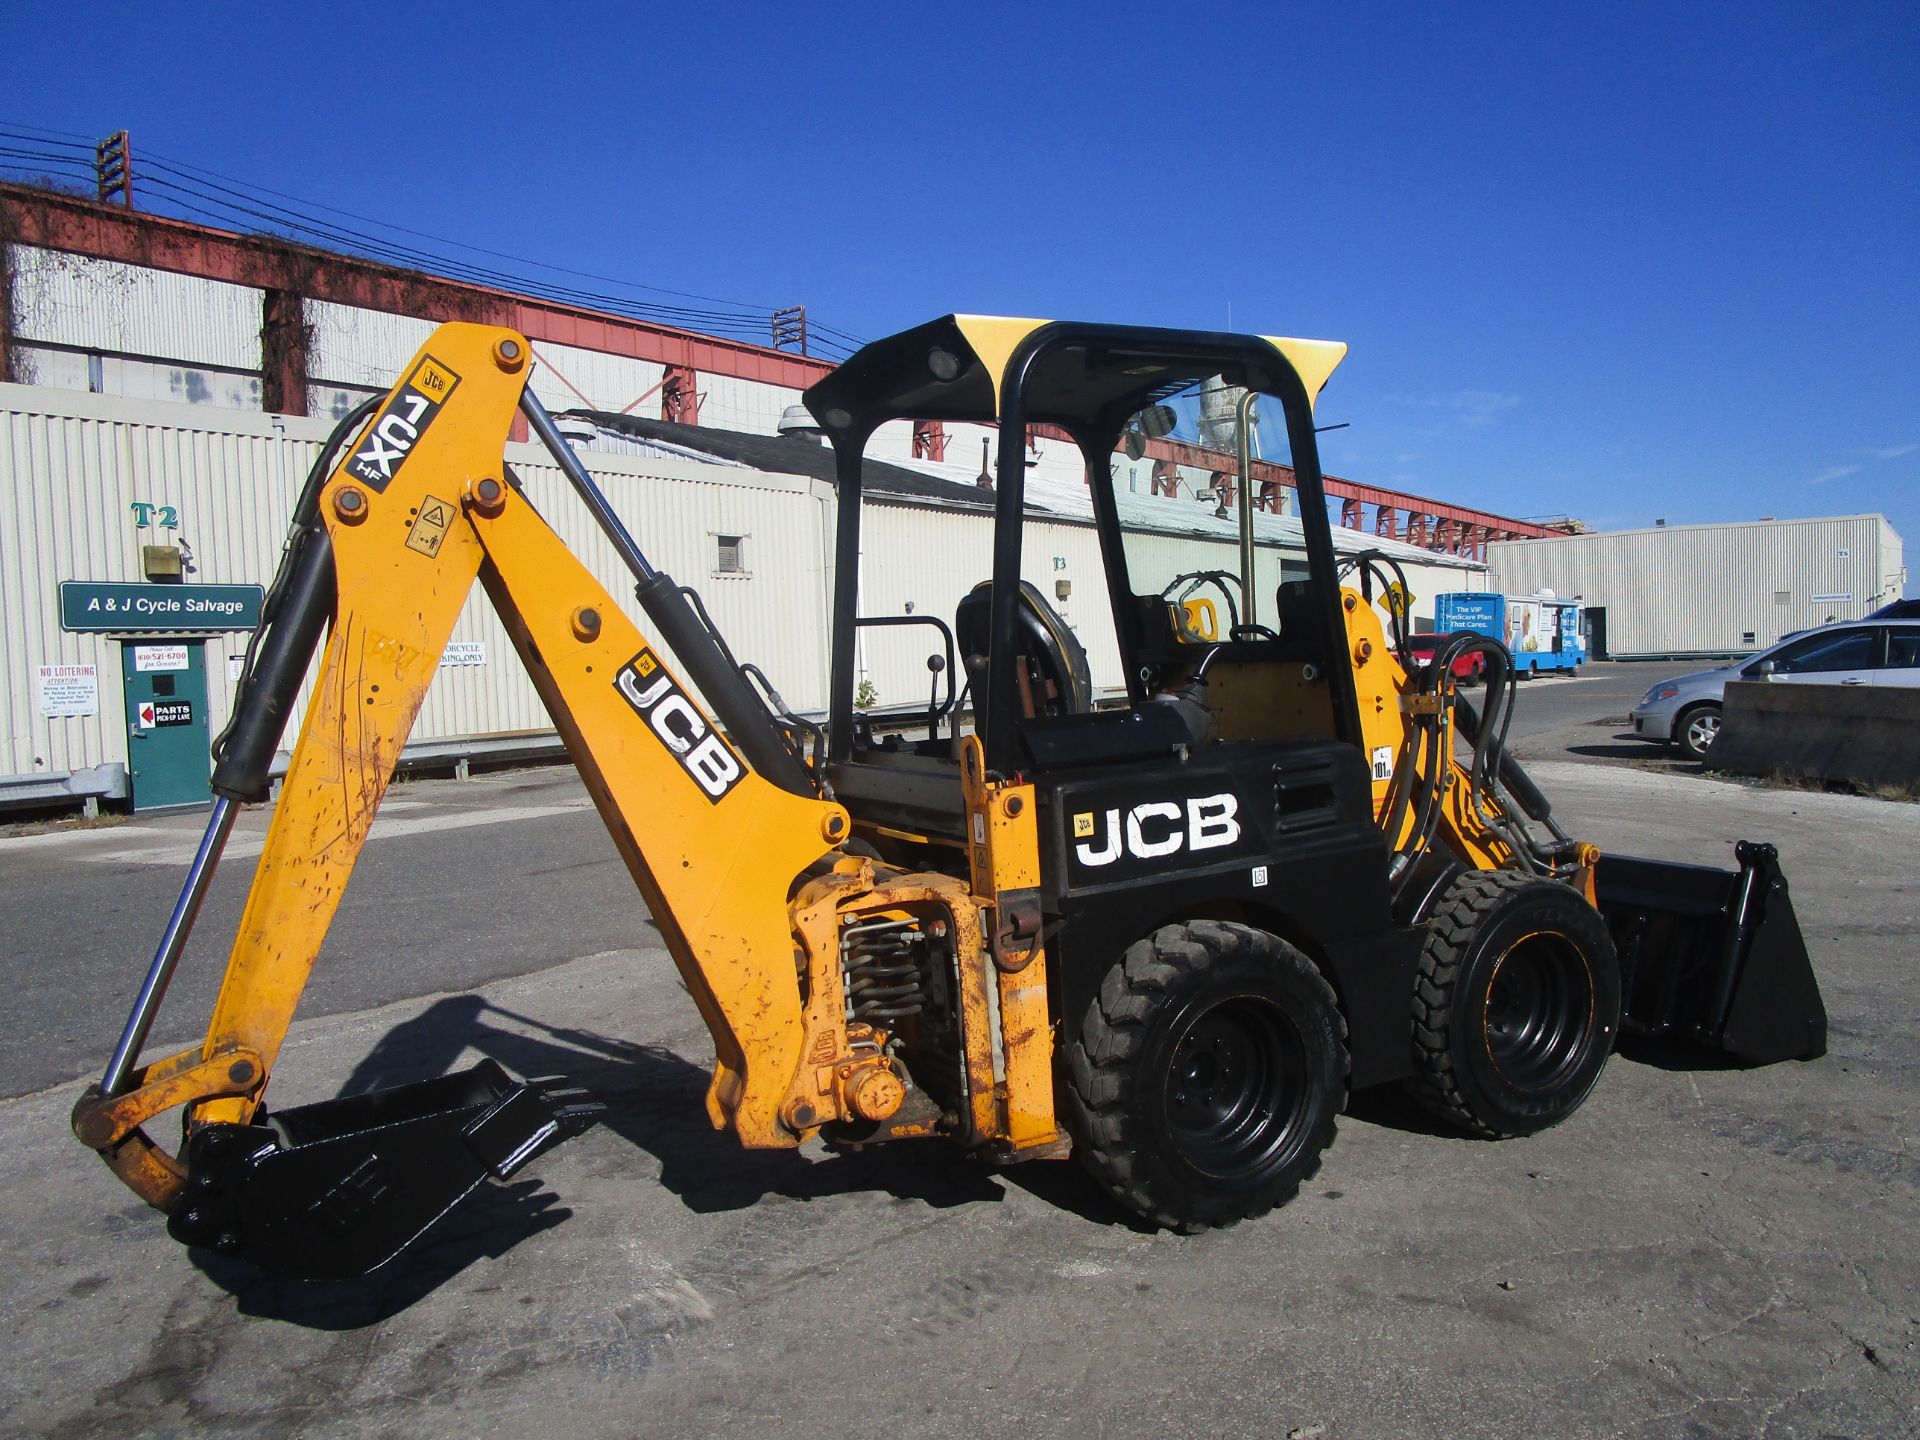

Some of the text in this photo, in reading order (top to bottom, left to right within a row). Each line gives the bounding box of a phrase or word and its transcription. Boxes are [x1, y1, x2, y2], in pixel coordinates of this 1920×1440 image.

[423, 370, 445, 391] JCB
[356, 395, 430, 478] 1CX
[356, 461, 382, 480] HF
[130, 501, 179, 529] T2
[88, 598, 244, 615] A & J Cycle Salvage
[152, 652, 187, 660] 521-6700
[441, 654, 460, 662] KING
[41, 667, 94, 677] NO LOITERING
[156, 705, 190, 715] PARTS
[157, 713, 176, 722] PICK-UP
[619, 668, 739, 796] JCB
[1374, 761, 1386, 778] 101
[1075, 793, 1241, 866] JCB
